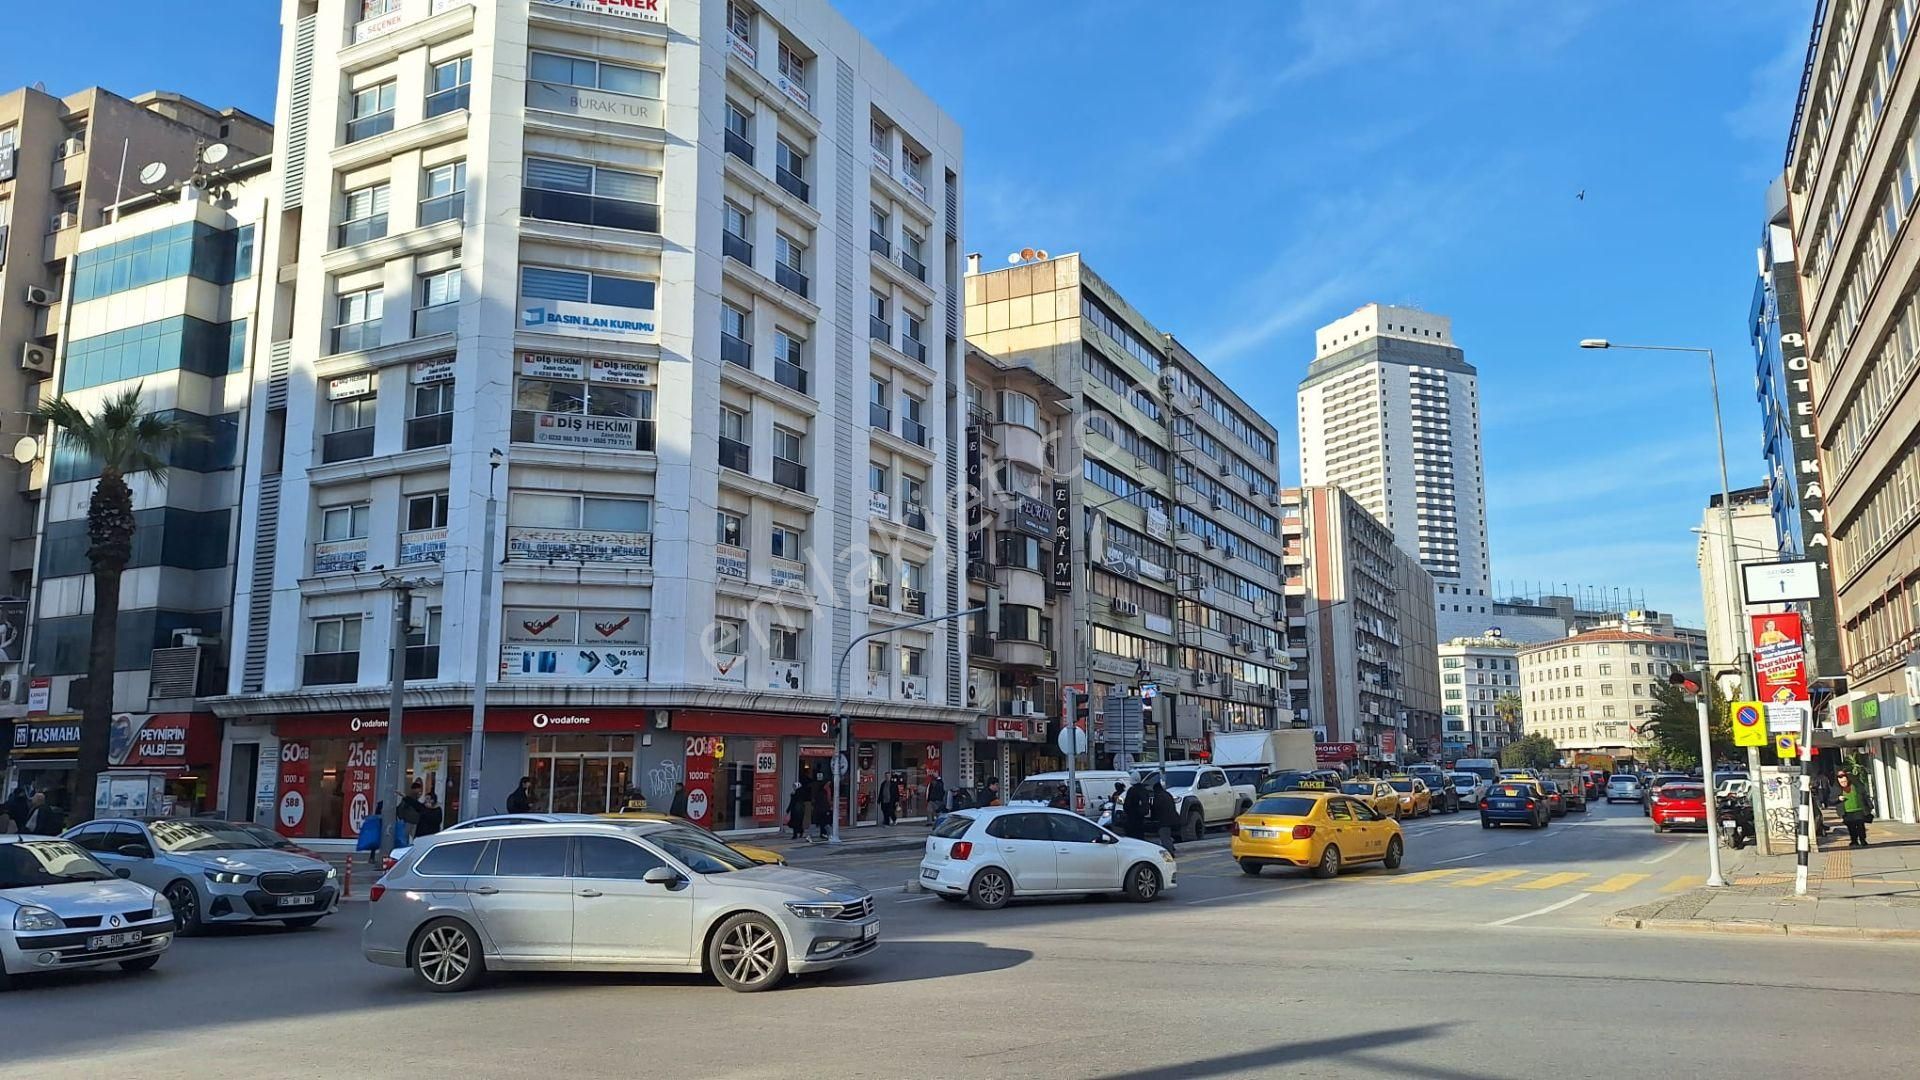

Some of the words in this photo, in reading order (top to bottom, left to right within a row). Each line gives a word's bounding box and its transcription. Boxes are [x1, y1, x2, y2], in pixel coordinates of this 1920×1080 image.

[570, 96, 617, 114] BURAK
[622, 103, 648, 118] TUR
[547, 312, 580, 324] BASIN
[582, 315, 608, 328] İLAN
[609, 318, 655, 332] KURUMU
[557, 417, 582, 431] DİŞ
[586, 419, 632, 433] HEKİMİ
[1801, 458, 1829, 549] KÂYA
[1055, 488, 1070, 576] ECRİN
[1757, 653, 1803, 670] bursluluk
[361, 719, 389, 728] vodafone
[549, 715, 591, 726] vodafone
[30, 726, 81, 743] TAŞMAHA
[140, 725, 186, 741] PEYNİR'İN
[138, 742, 167, 757] KALBİ
[758, 756, 773, 770] 569
[689, 771, 705, 780] 1000
[288, 815, 296, 825] TL
